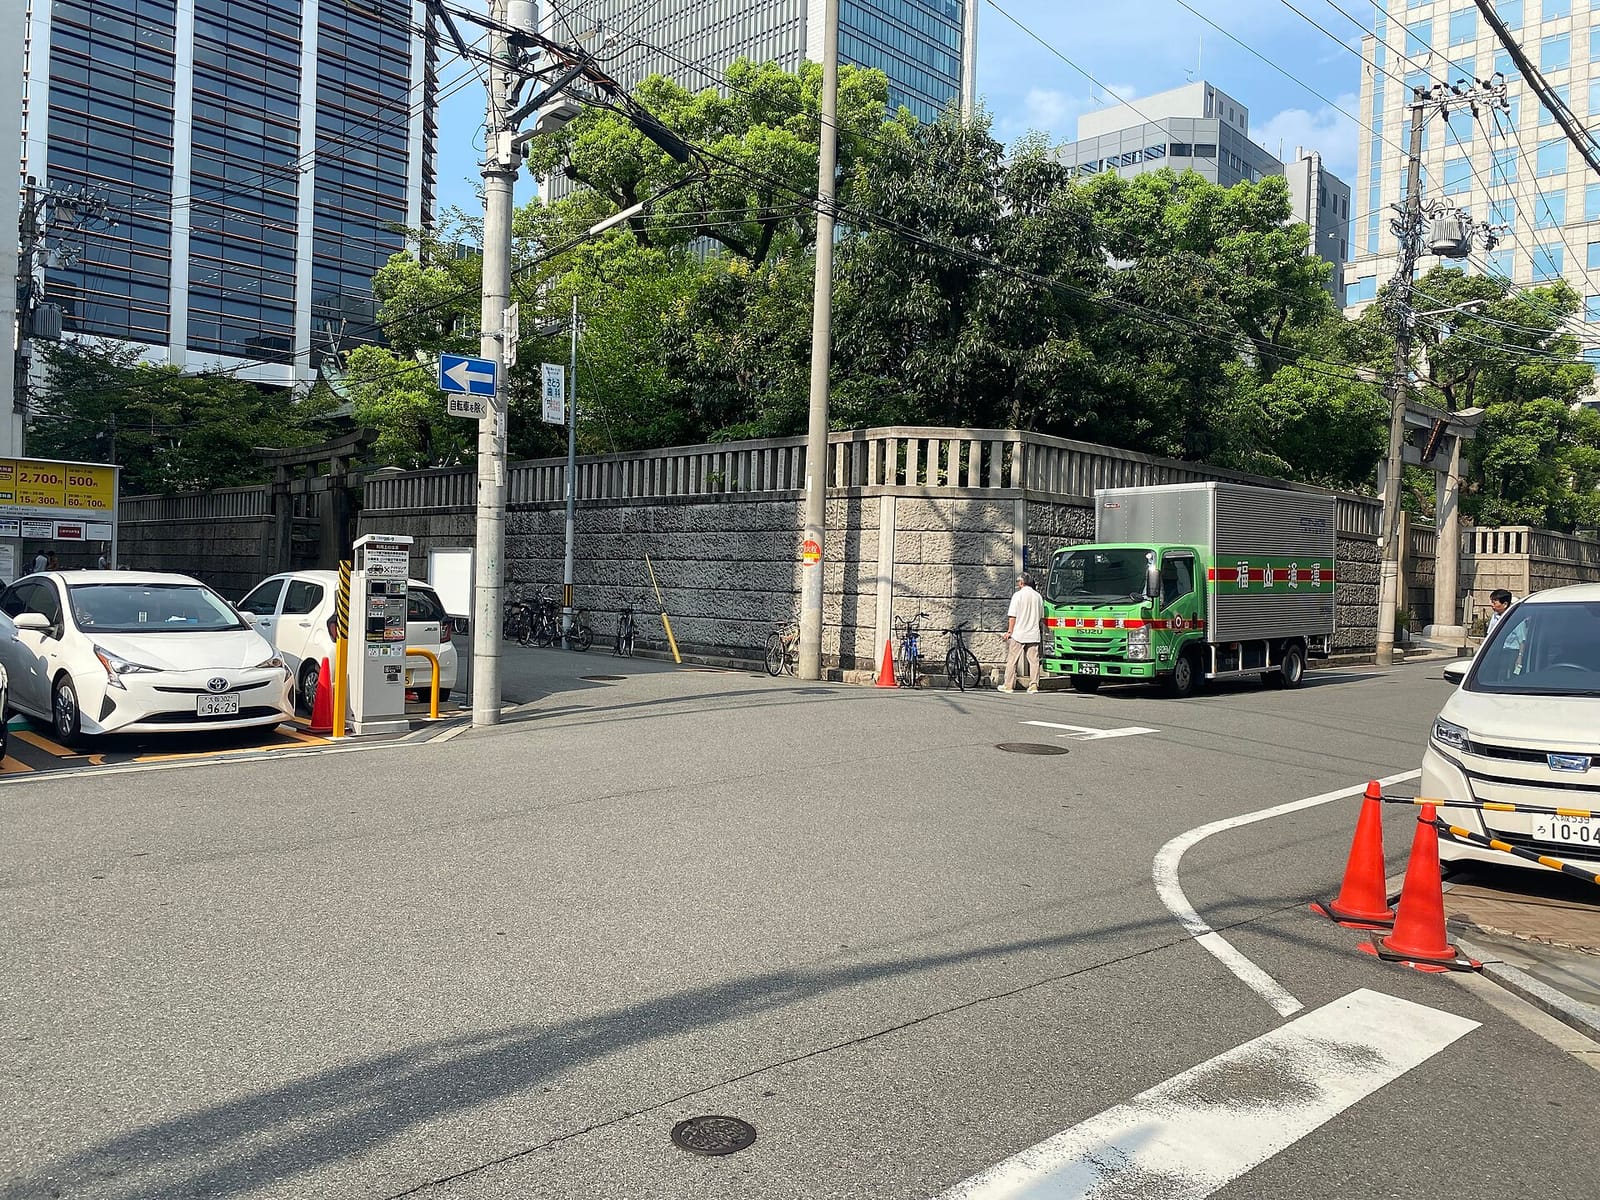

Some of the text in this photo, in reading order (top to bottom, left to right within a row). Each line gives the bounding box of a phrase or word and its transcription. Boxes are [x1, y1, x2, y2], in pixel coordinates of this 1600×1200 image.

[450, 399, 486, 415] 自転車を除く
[207, 702, 237, 714] 96-29
[1551, 822, 1600, 843] 10-04
